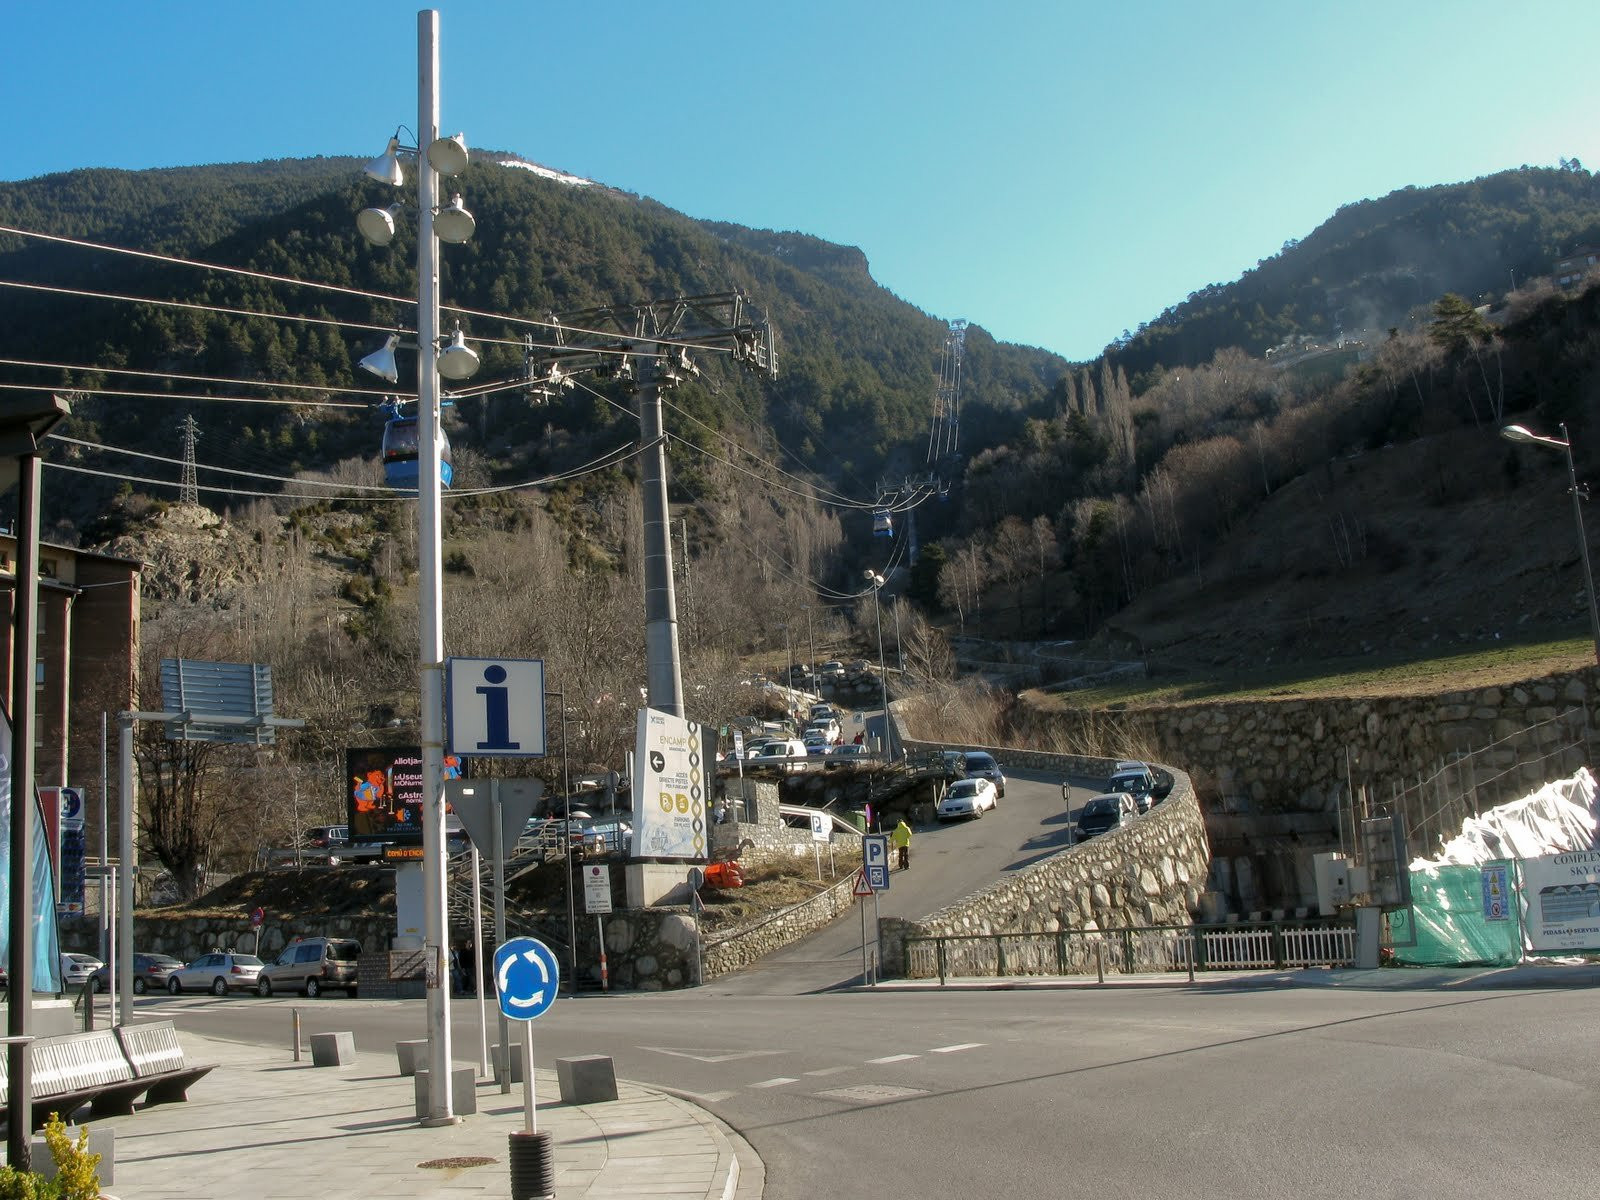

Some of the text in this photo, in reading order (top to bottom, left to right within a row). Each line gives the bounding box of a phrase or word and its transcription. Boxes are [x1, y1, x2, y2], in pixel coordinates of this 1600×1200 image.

[476, 664, 520, 750] i
[659, 735, 687, 748] ENCAMP
[870, 843, 881, 861] P
[1570, 865, 1589, 875] SKY
